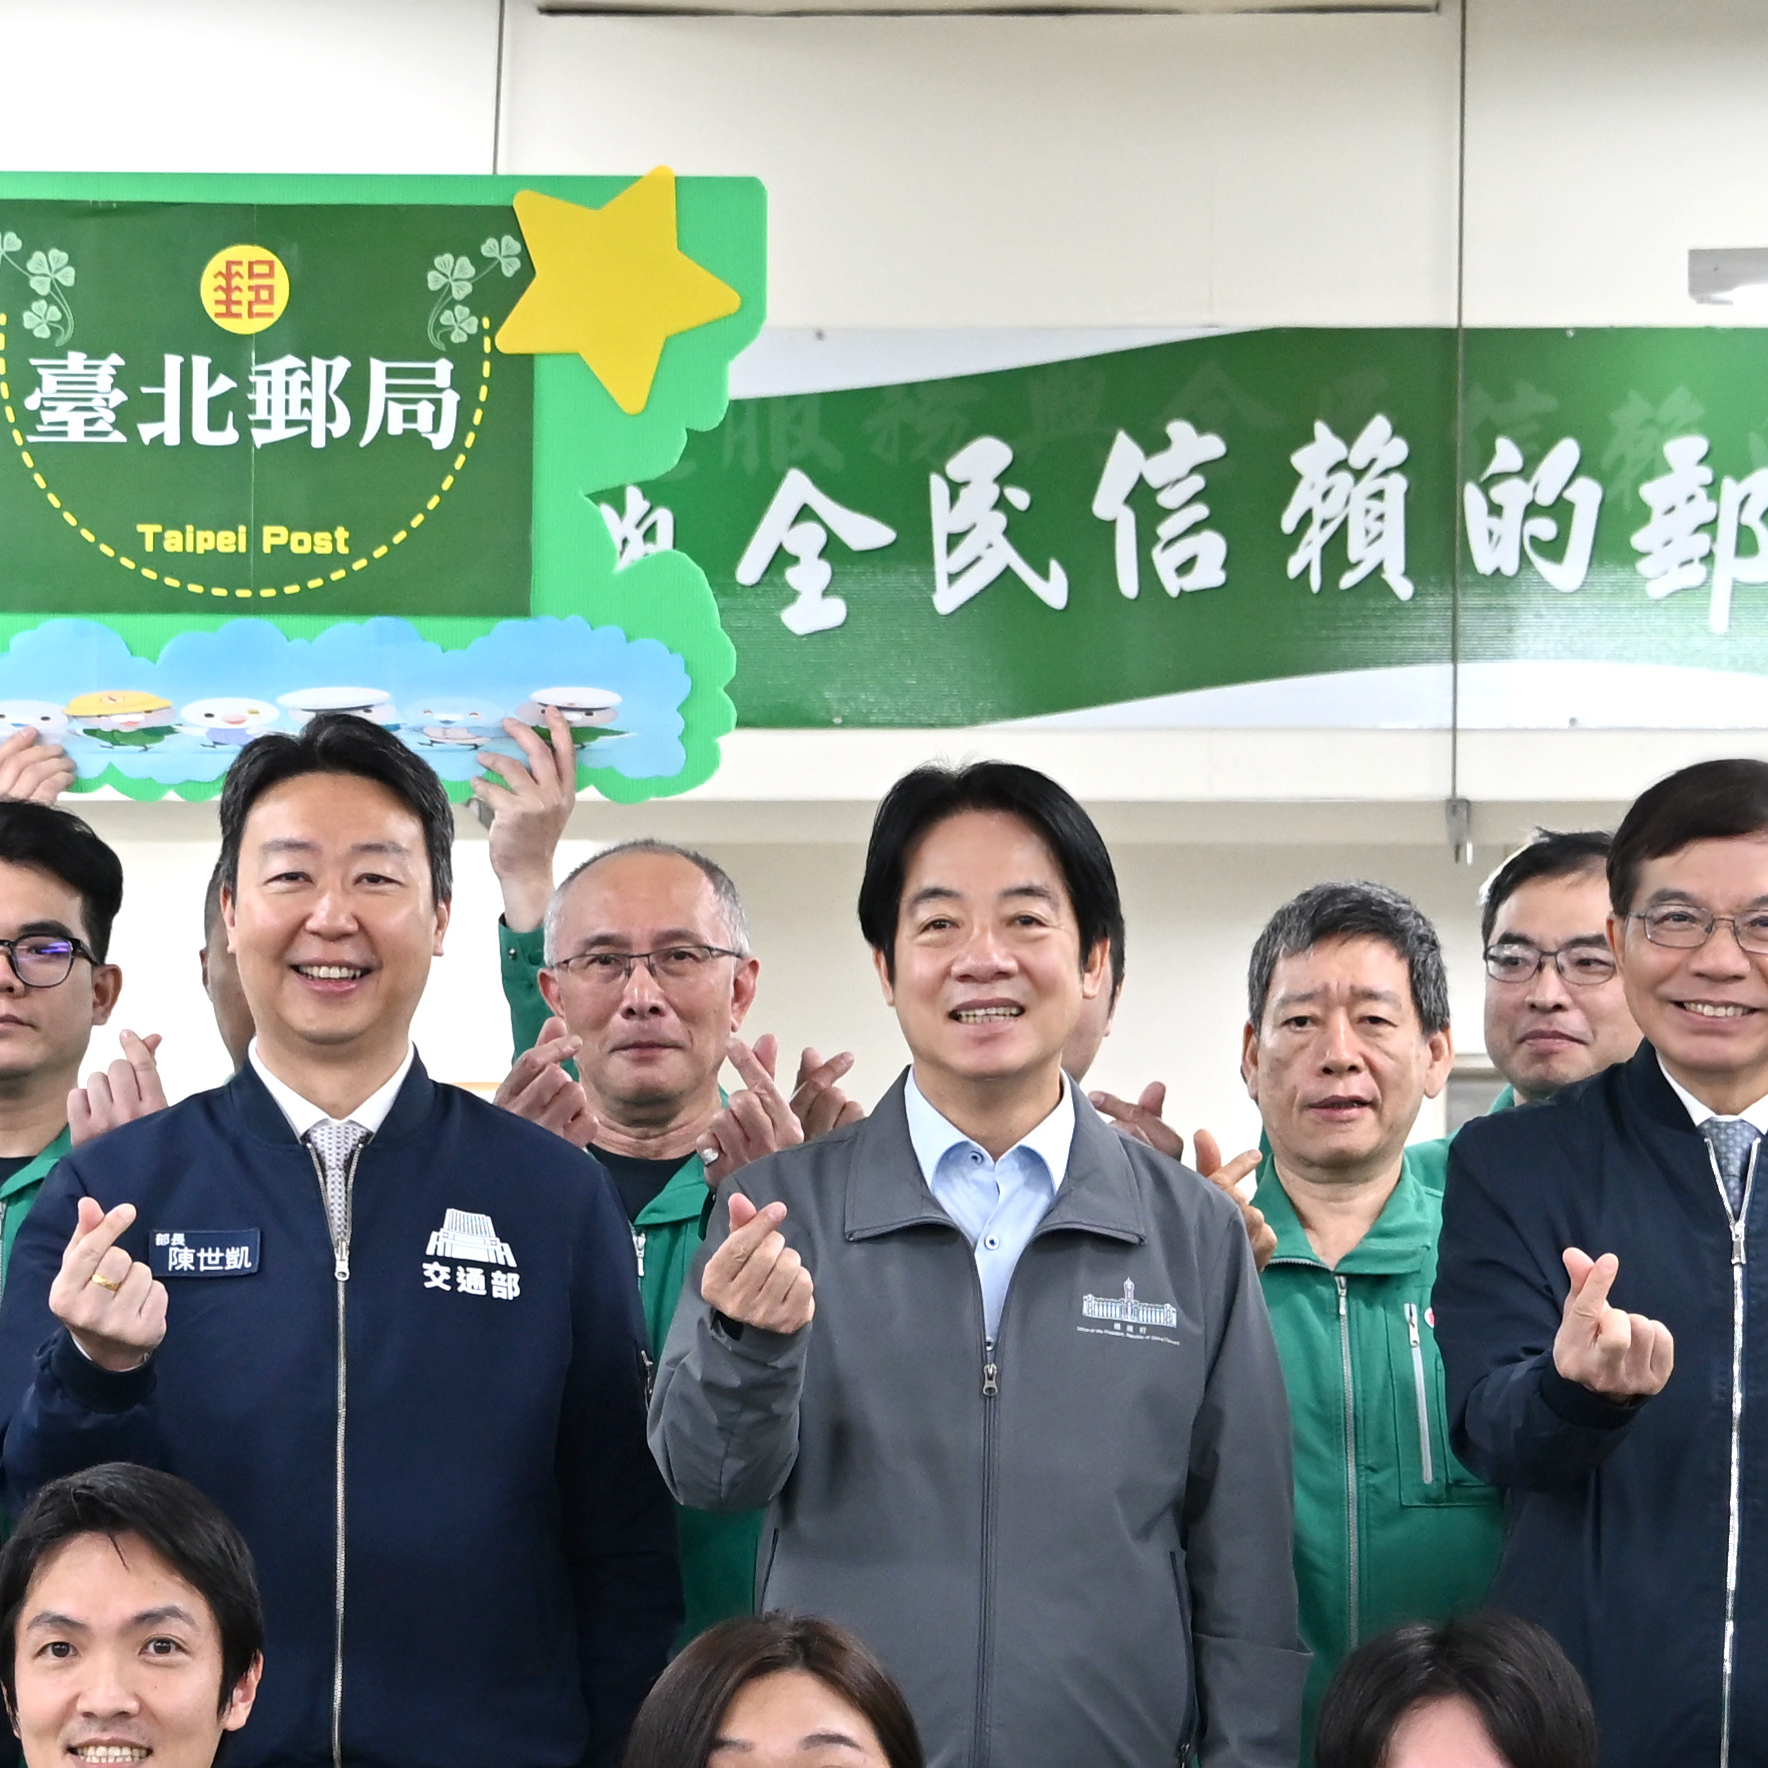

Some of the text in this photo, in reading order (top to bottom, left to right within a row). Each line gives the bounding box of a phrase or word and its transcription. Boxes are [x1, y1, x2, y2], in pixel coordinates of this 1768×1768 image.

[213, 258, 277, 319] 郵
[24, 350, 462, 450] 臺北郵局
[136, 523, 350, 554] Taipei Post
[154, 1232, 186, 1247] 部長
[167, 1245, 253, 1272] 陳世凱
[421, 1261, 521, 1300] 交通部
